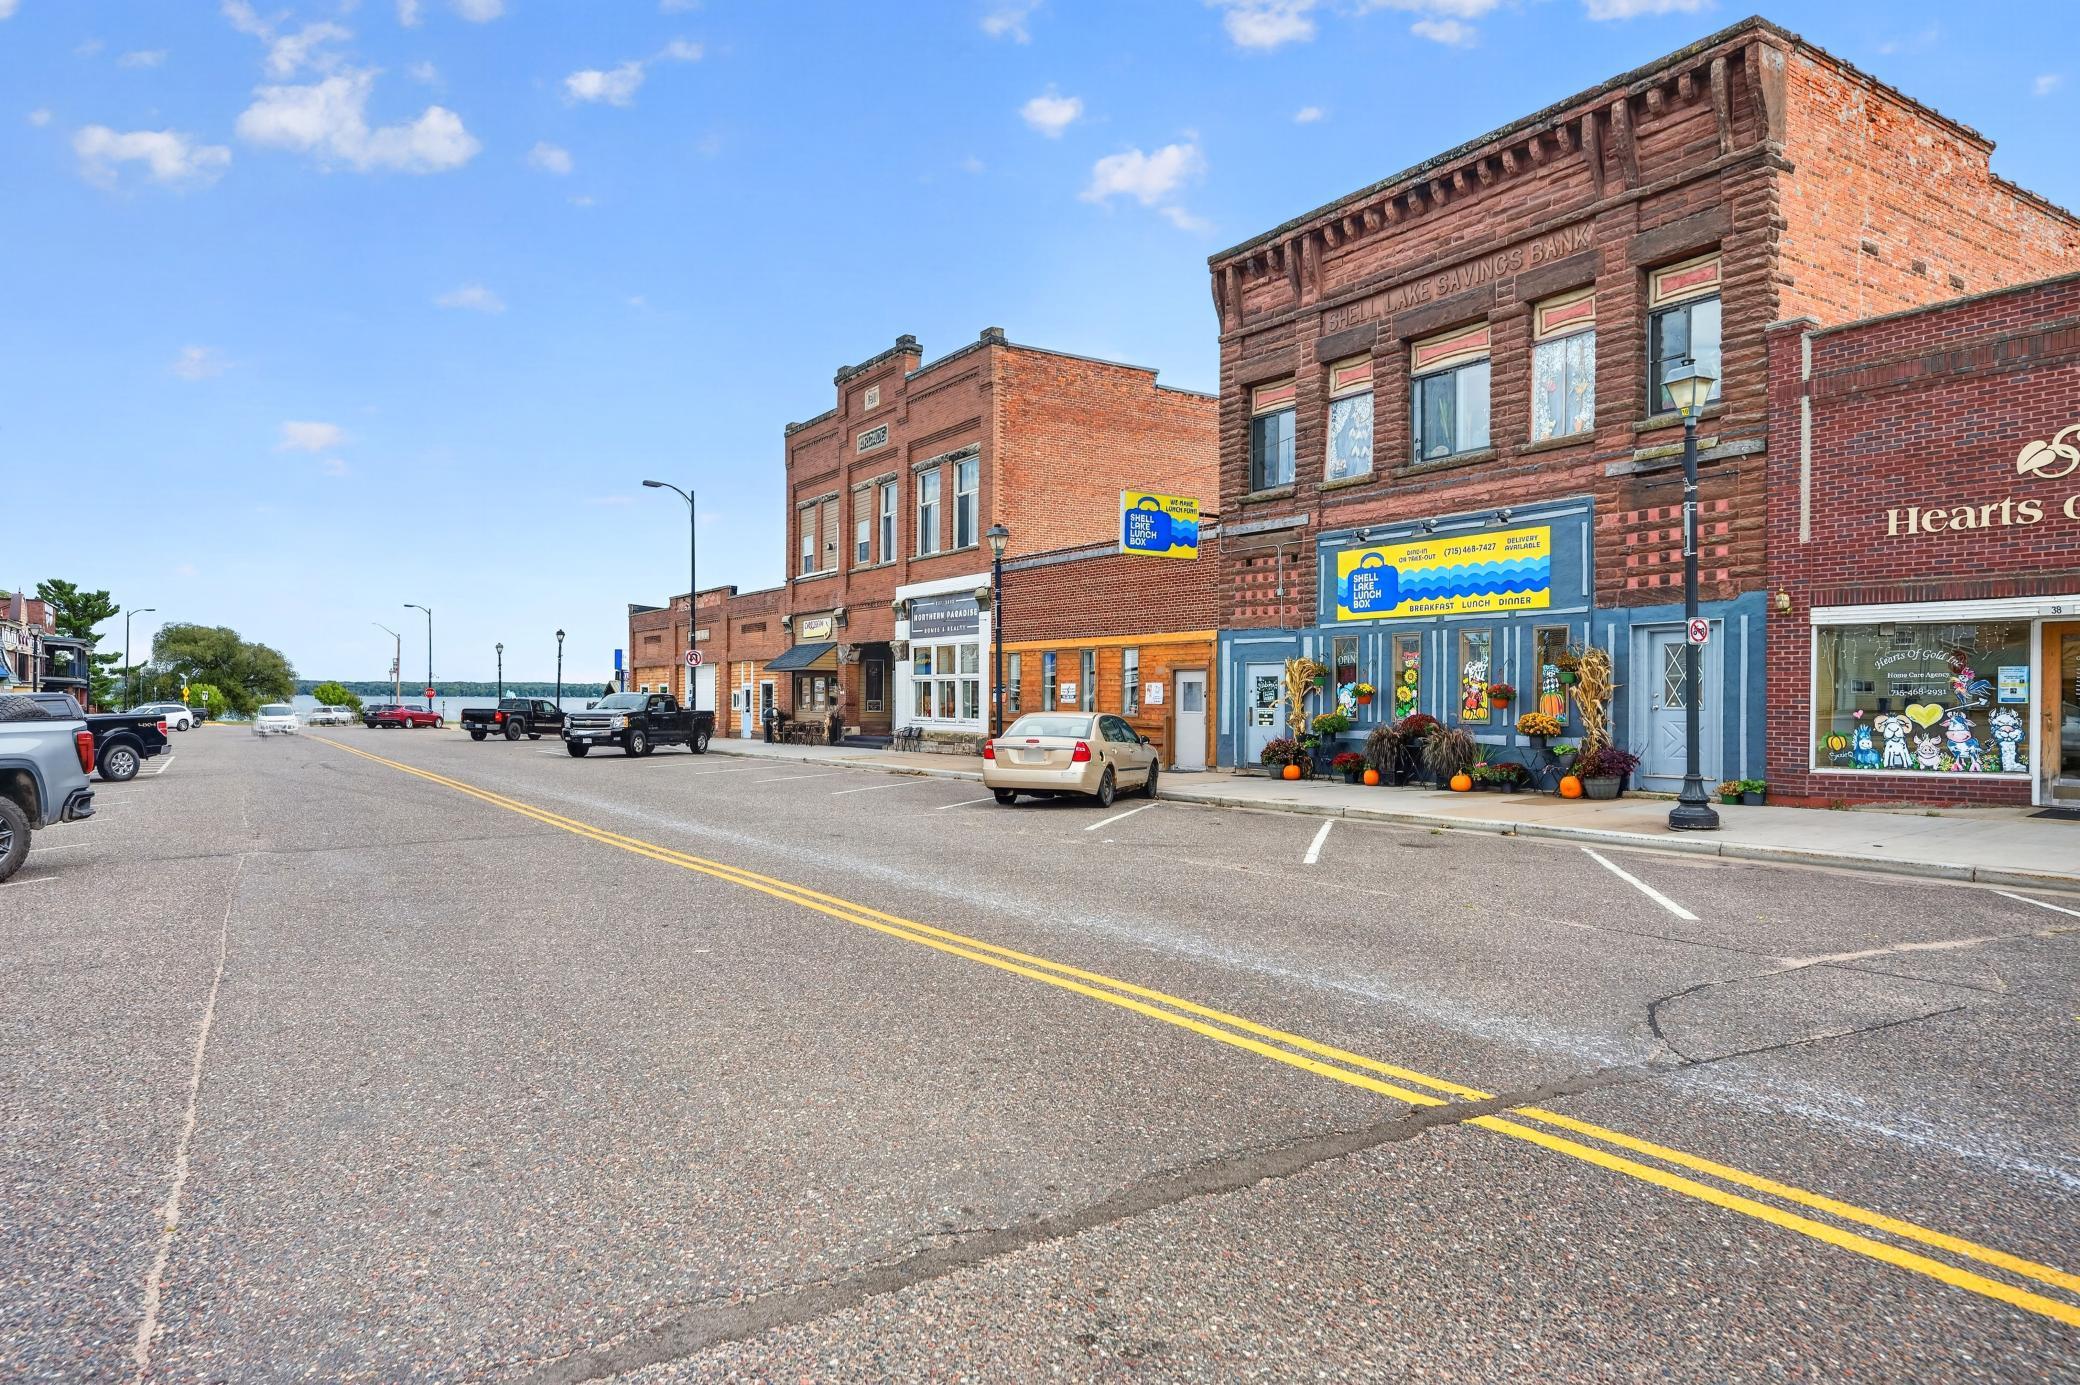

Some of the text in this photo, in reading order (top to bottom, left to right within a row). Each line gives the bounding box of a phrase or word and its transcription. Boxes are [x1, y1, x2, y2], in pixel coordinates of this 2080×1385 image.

[1327, 223, 1591, 332] SHELL LAKE SAVINGS BANK
[860, 427, 887, 450] ARCADE
[1130, 513, 1154, 523] SHELL
[1886, 495, 2044, 536] Hearts
[1130, 522, 1150, 530] LAKE
[1130, 530, 1157, 539] LUNCH
[1506, 535, 1539, 544] DELIVERY
[1130, 538, 1146, 546] BOX
[1504, 542, 1541, 551] AVAILABLE
[1443, 542, 1497, 558] (715) 468-7427
[1353, 572, 1379, 583] SHELL
[1353, 582, 1375, 591] LAKE
[1353, 590, 1382, 600] LUNCH
[1353, 600, 1371, 609] BOX
[1409, 597, 1532, 612] BREAKFAST LUNCH DINNER
[914, 608, 978, 621] NORTHERN PARADISE
[2051, 606, 2062, 614] 38
[1338, 653, 1356, 665] OPEN
[1874, 652, 1906, 670] Hearts
[1907, 648, 1922, 660] Of
[1922, 649, 1949, 660] Gold
[1887, 671, 1908, 679] Home
[1925, 671, 1951, 679] Agency
[1891, 687, 1947, 697] 715-468-2931
